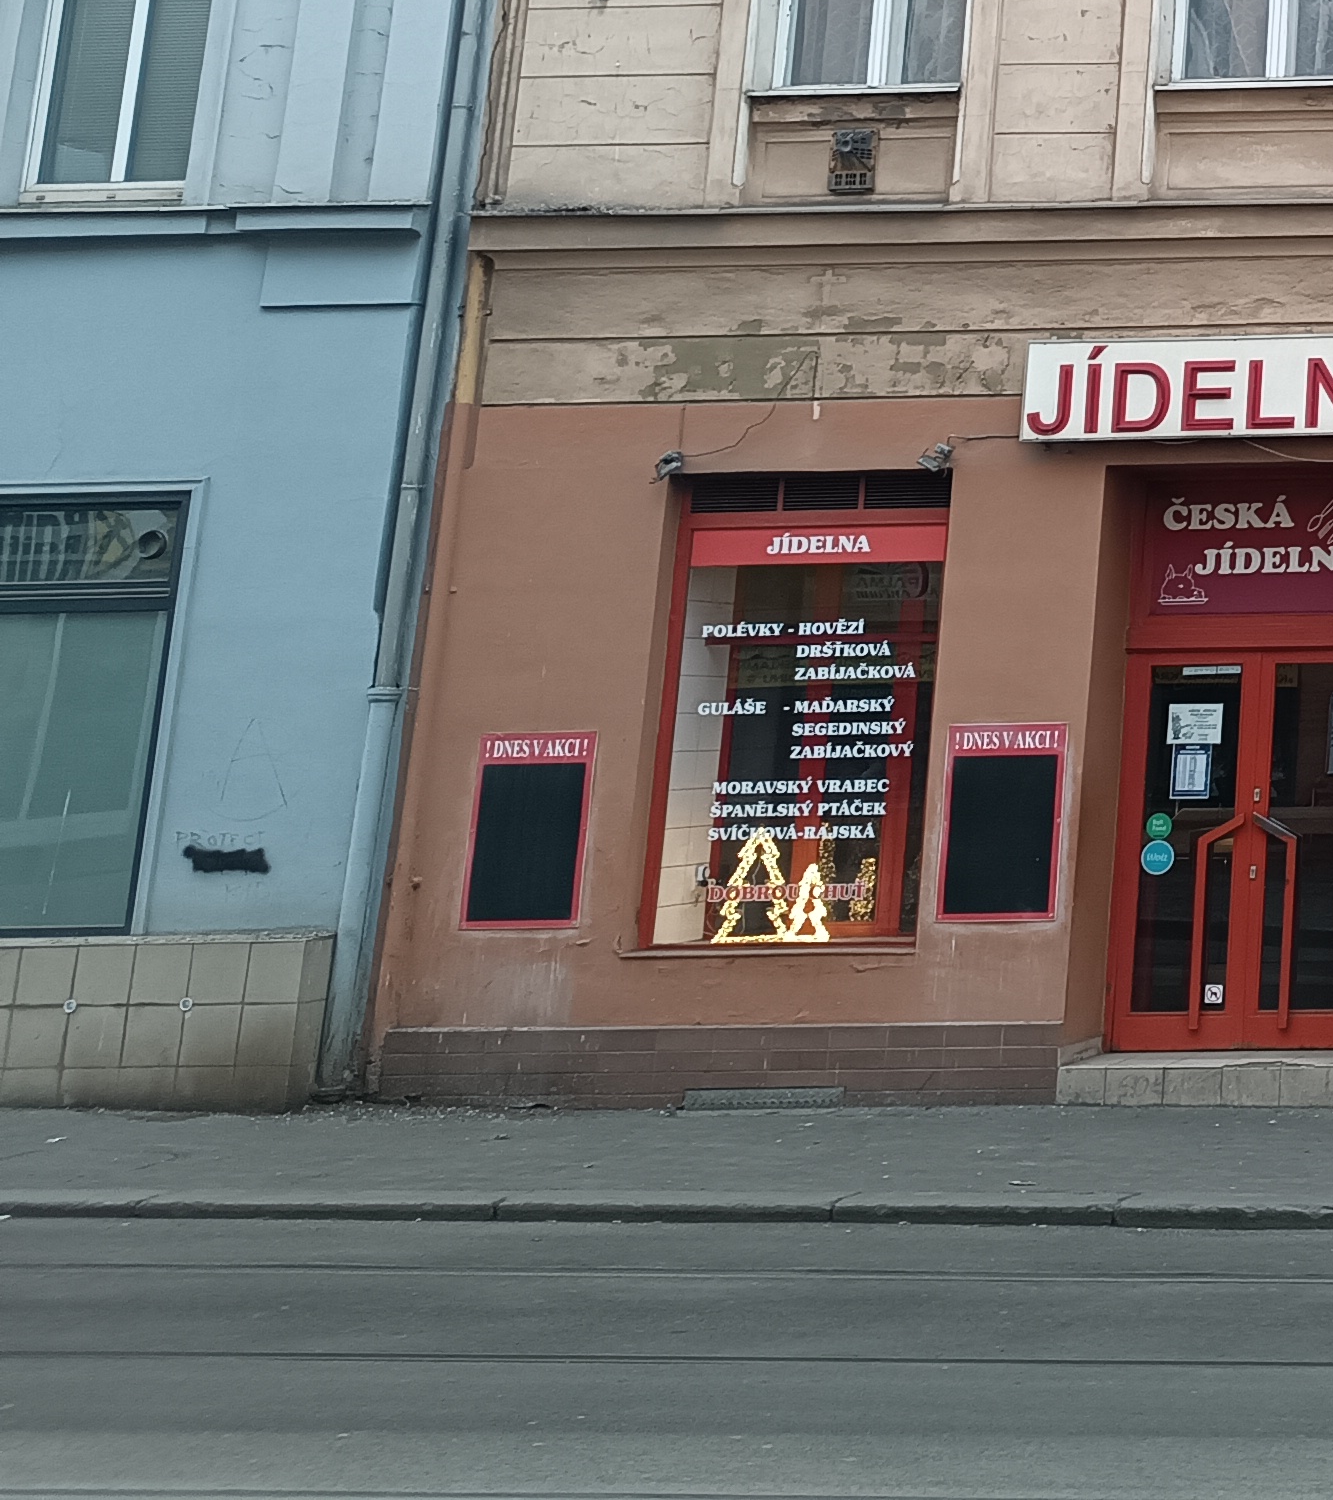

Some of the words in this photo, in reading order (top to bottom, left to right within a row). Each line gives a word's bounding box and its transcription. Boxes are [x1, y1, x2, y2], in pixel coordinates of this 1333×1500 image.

[1162, 495, 1295, 531] ČESKÁ
[766, 532, 871, 555] JÍDELNA
[701, 621, 784, 638] POLÉVKY
[798, 618, 865, 636] HOVĚZÍ
[796, 640, 891, 658] DRŠŤKOVÁ
[794, 662, 916, 681] ZABÍJAČKOVÁ
[698, 698, 767, 716] GULÁŠE
[793, 696, 895, 714] MAĎARSKÝ
[791, 718, 906, 737] SEGEDINSKÝ
[492, 740, 530, 758] DNES
[532, 740, 545, 757] V
[543, 738, 581, 757] AKCI
[789, 740, 914, 760] ZABÍJAČKOVÝ
[962, 732, 1000, 750] DNES
[1002, 731, 1014, 749] V
[1014, 730, 1052, 749] AKCI
[711, 776, 814, 795] MORAVSKÝ
[816, 778, 890, 793] VRABEC
[709, 799, 814, 818] ŠPANĚLSKÝ
[816, 799, 887, 816] PTÁČEK
